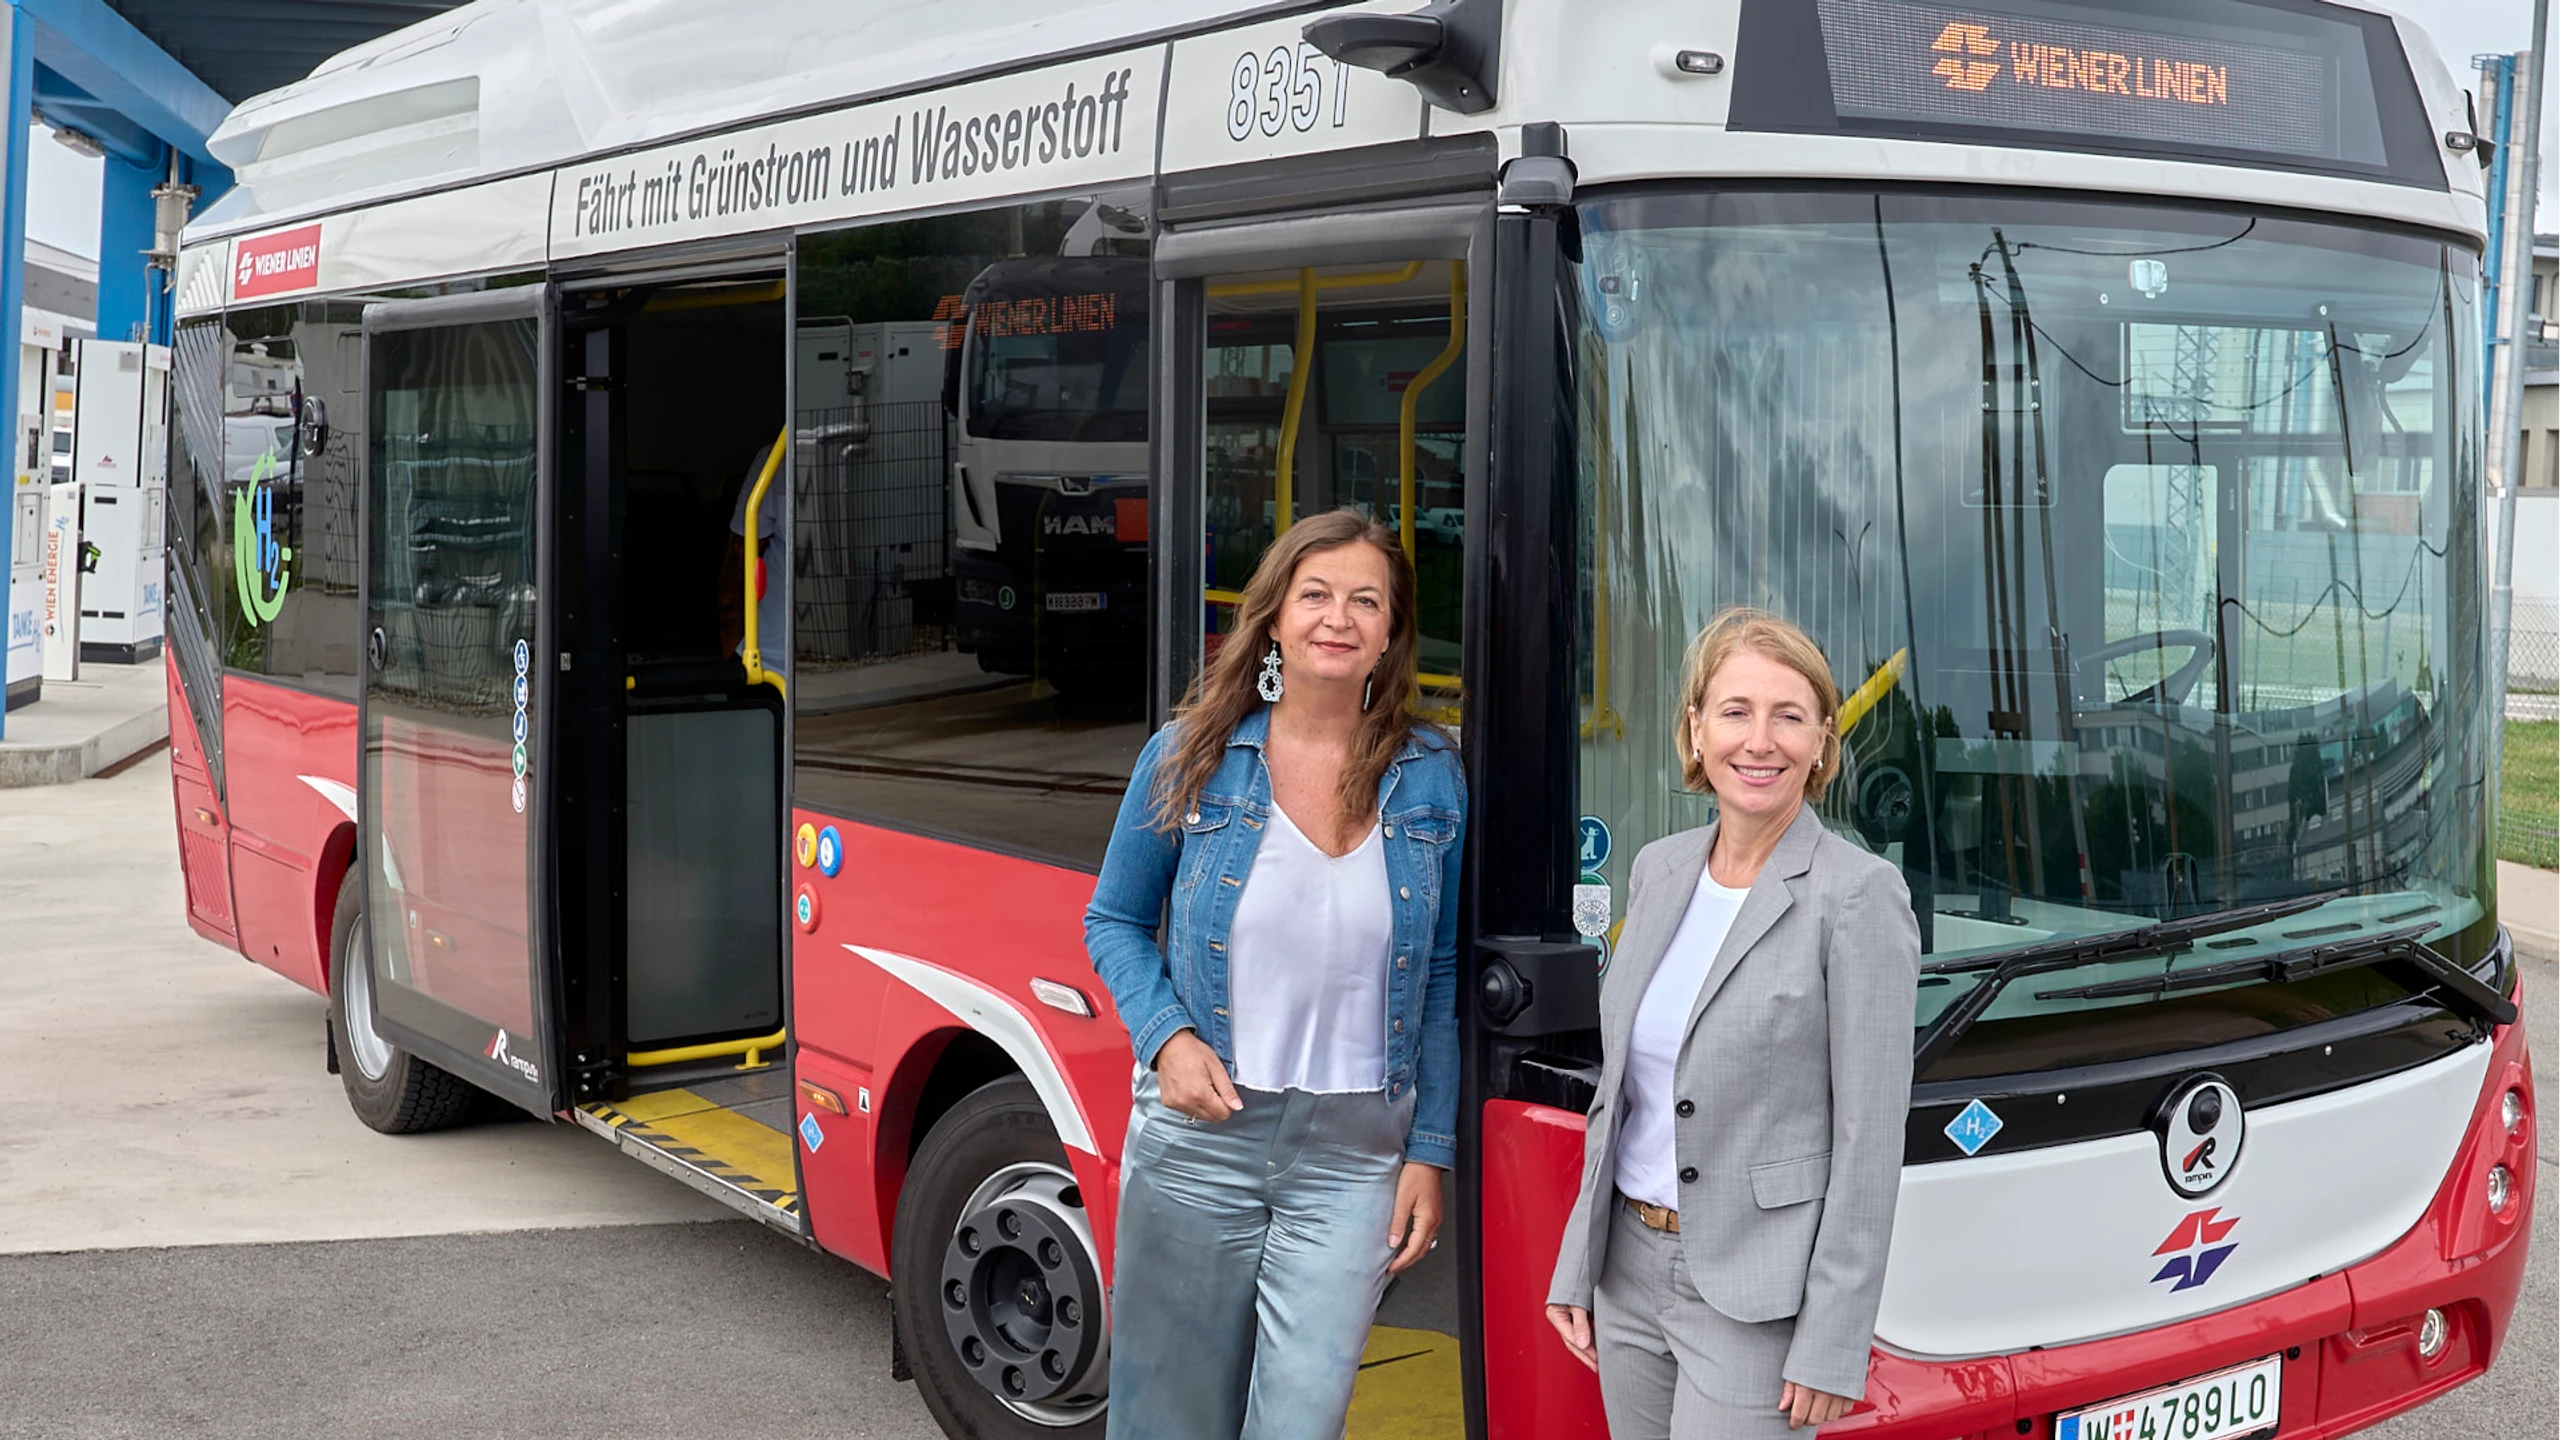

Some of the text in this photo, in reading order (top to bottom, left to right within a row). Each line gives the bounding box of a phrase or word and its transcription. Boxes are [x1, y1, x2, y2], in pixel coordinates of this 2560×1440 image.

[1227, 41, 1349, 142] 8351
[2010, 41, 2227, 105] WIENER LINIEN
[575, 67, 1132, 238] Fährt mit Grünstrom und Wasserstoff
[255, 244, 316, 276] WIENER LINIEN
[973, 293, 1116, 337] WIENER LINIEN
[45, 531, 59, 621] WIEN ENERGIE
[2138, 1373, 2267, 1440] 4789LO
